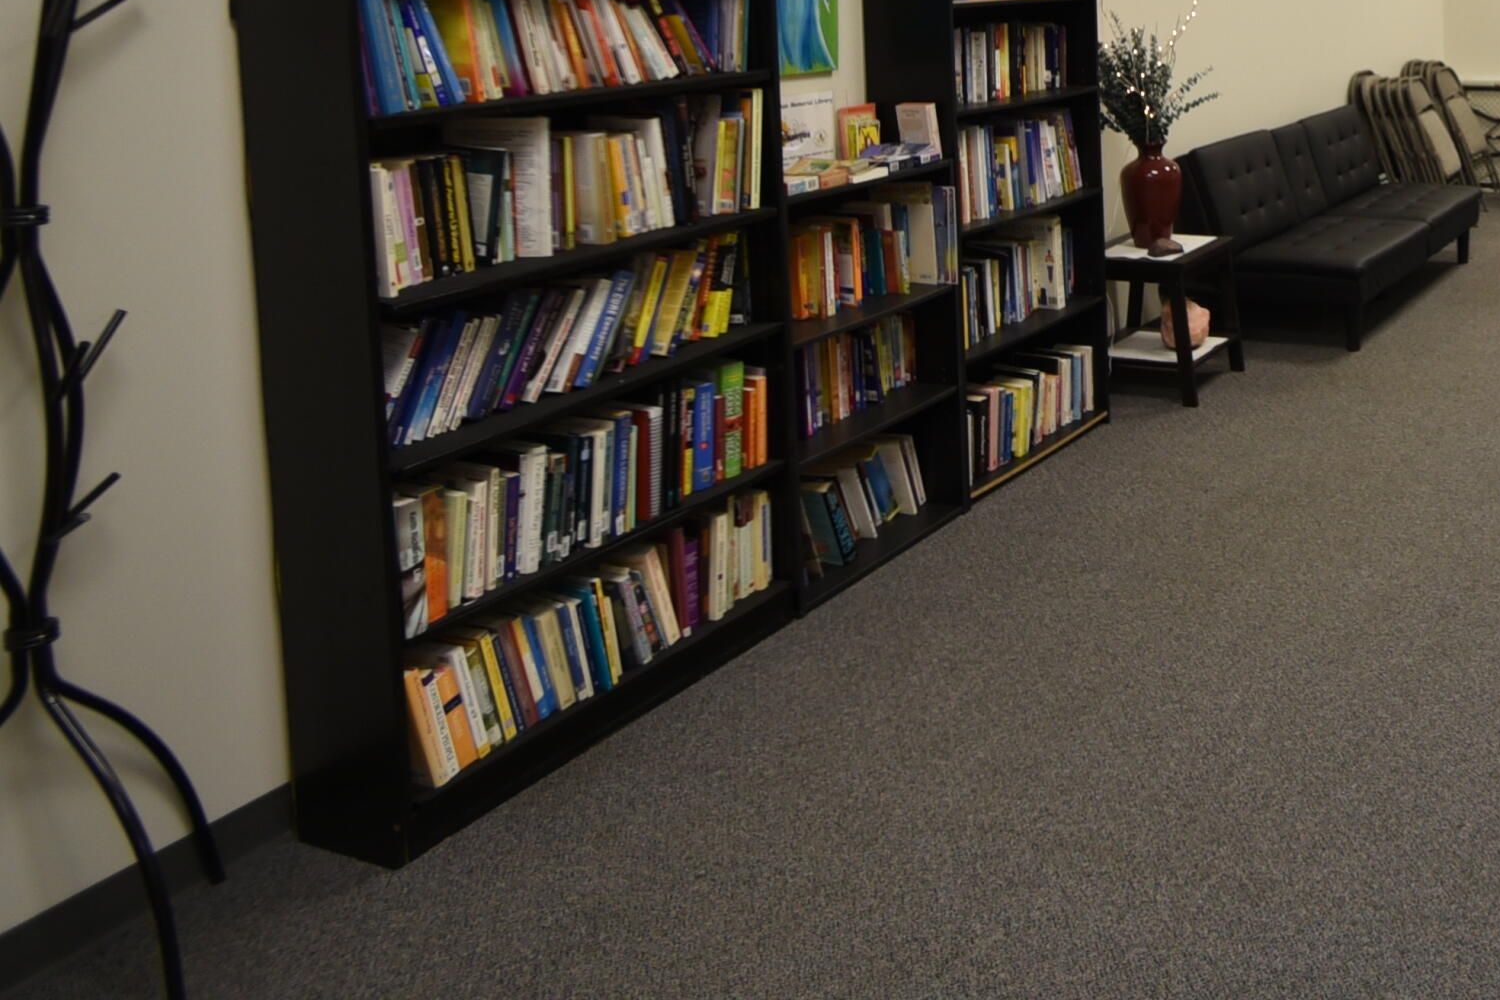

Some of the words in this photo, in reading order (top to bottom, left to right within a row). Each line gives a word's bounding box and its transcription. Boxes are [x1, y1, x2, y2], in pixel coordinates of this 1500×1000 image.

[616, 279, 629, 292] The
[606, 292, 624, 315] CURE
[590, 315, 614, 361] Conspiracy
